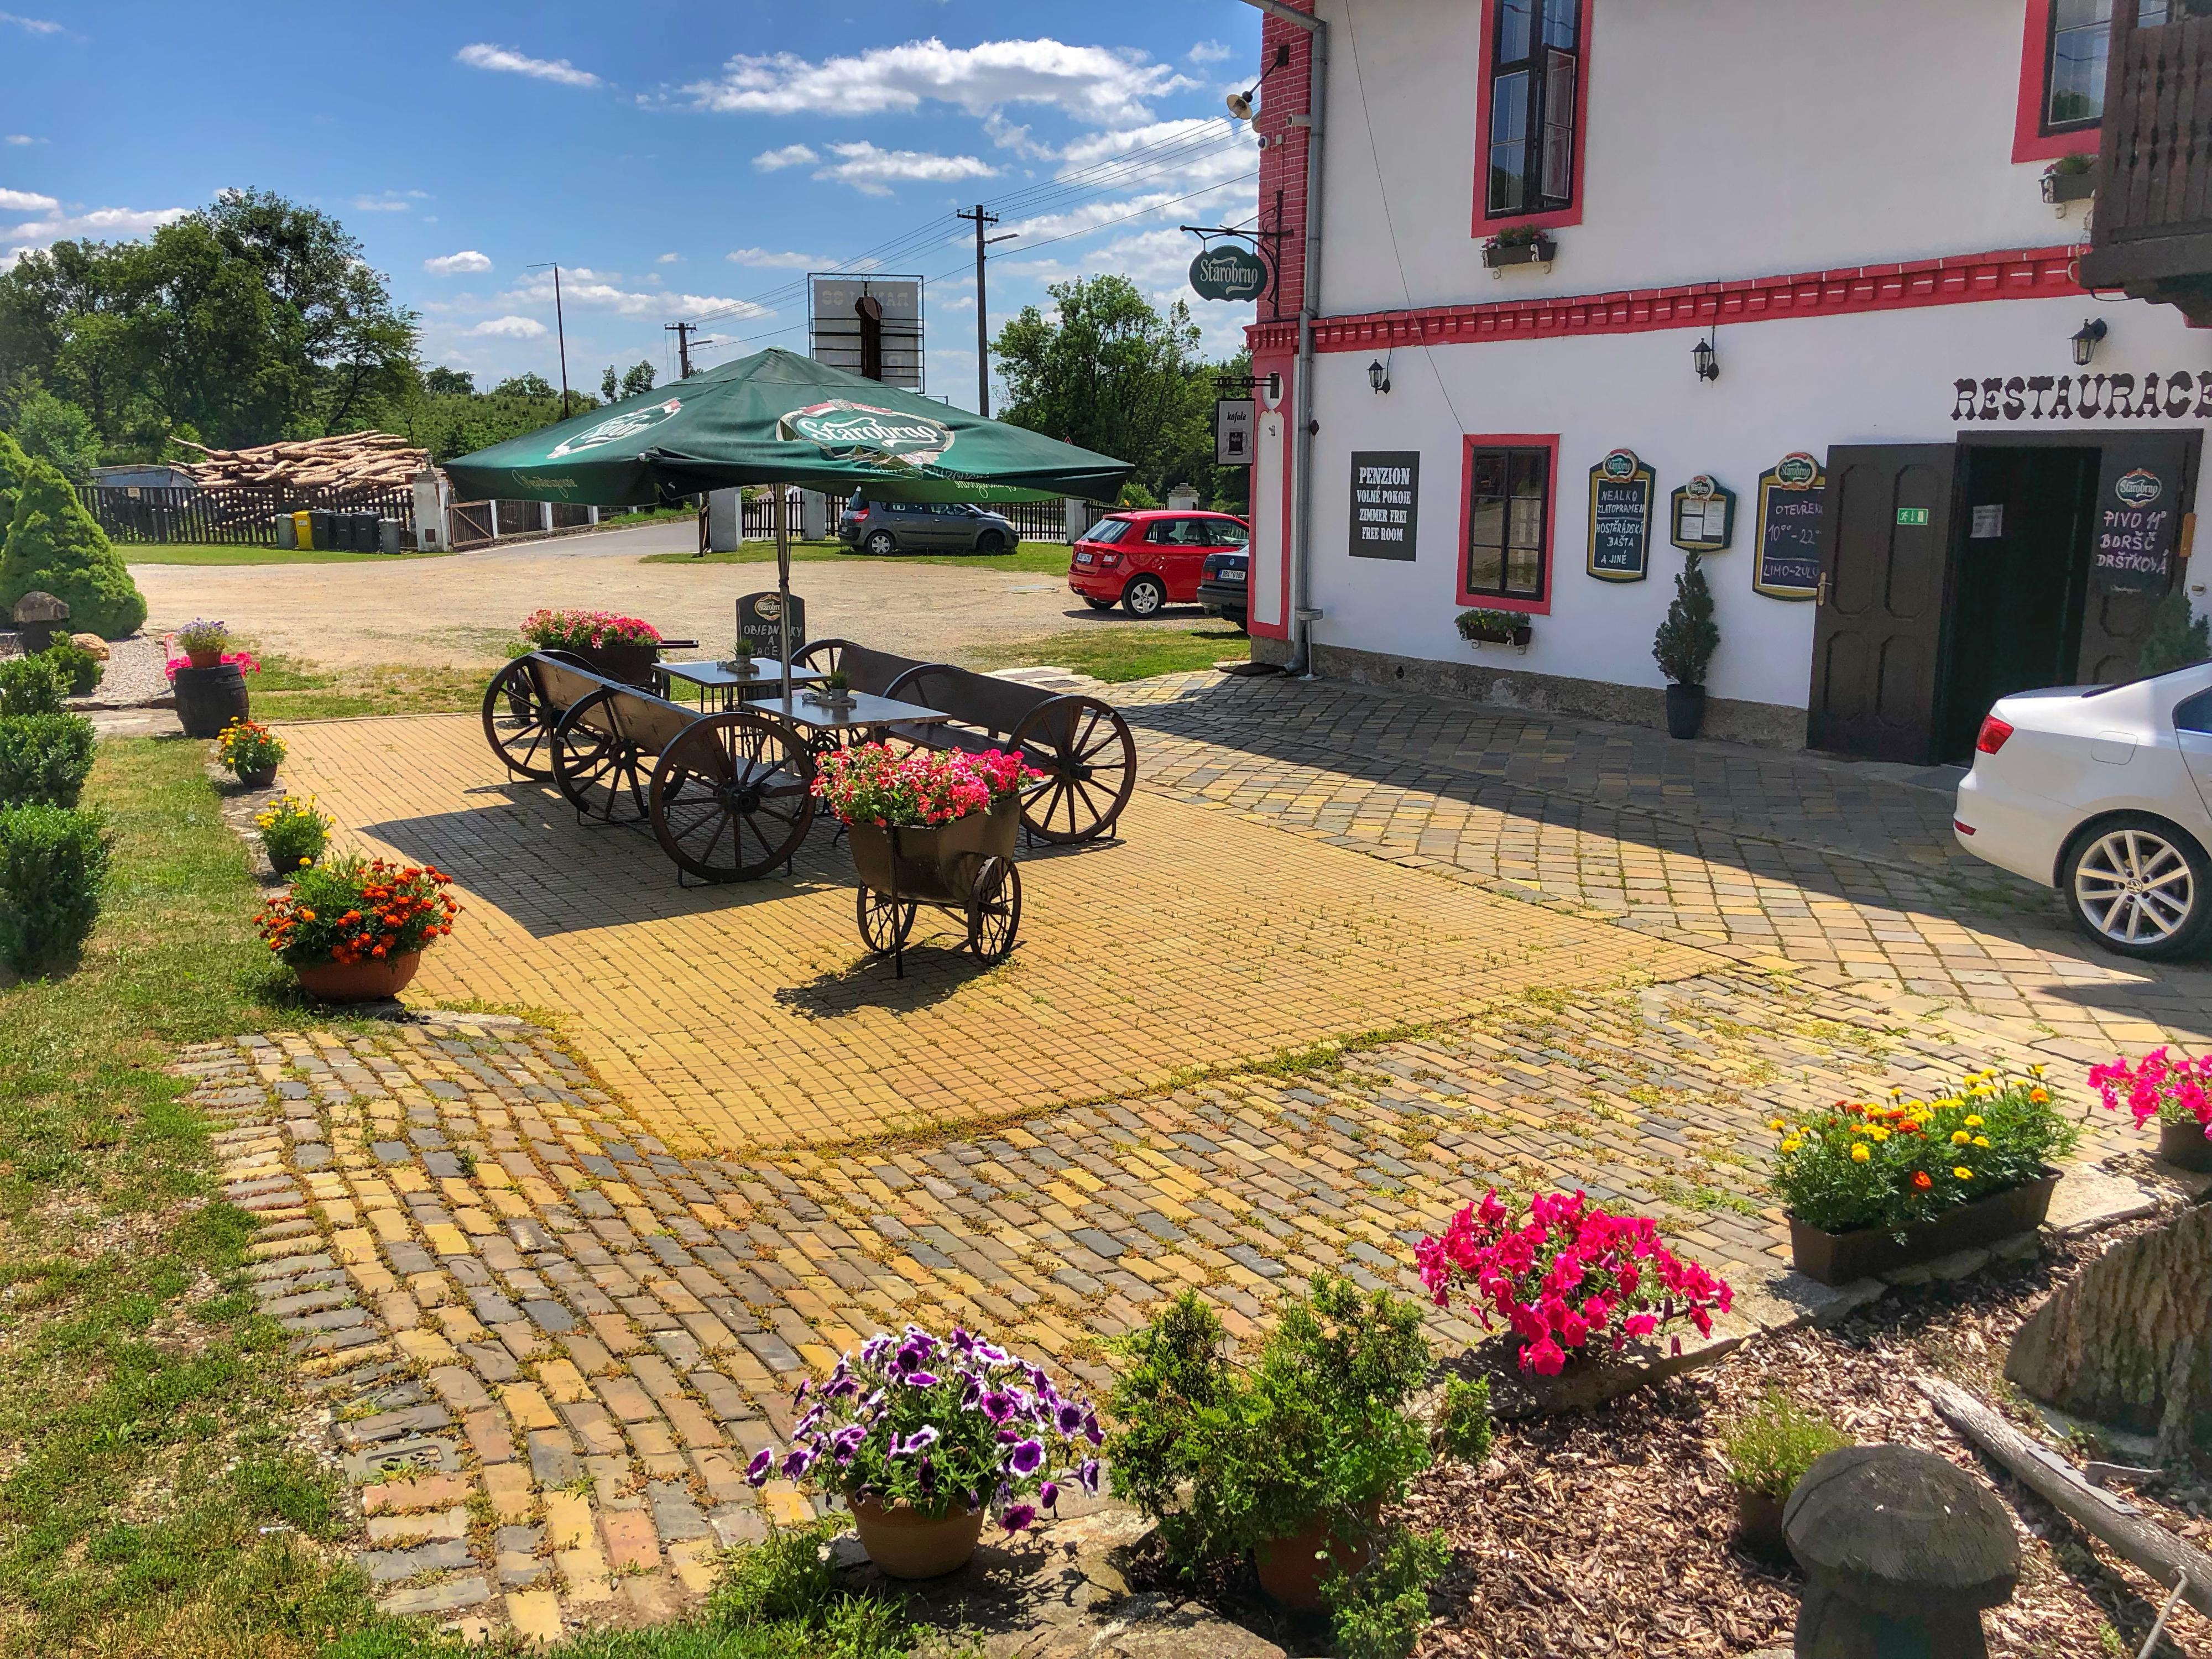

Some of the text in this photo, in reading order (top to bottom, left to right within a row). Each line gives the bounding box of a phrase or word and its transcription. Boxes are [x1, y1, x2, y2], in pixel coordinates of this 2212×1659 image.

[1200, 256, 1258, 295] Starobrno
[1950, 371, 2212, 421] RESTAURACE
[1227, 411, 1247, 424] kofola
[801, 417, 939, 447] Starobrno
[1606, 458, 1631, 474] Starobrno
[1780, 463, 1811, 481] Starobrno
[1359, 467, 1410, 485] PENZION
[1357, 485, 1411, 504] VOLNÉ POKOJE
[1601, 490, 1637, 501] NEALKO
[2120, 479, 2158, 498] Starobrno
[1597, 504, 1645, 514] ZLATOPRAMEN
[1775, 500, 1823, 515] OTEVŘEN
[1359, 508, 1407, 523] ZIMMER FREI
[2104, 510, 2142, 529] PIVO
[1361, 526, 1404, 541] FREE ROOM
[1606, 535, 1634, 547] BAŠTA
[2100, 530, 2157, 550] BORŠČ
[1601, 550, 1627, 565] A JINÉ
[2096, 549, 2169, 575] DRŠŤKOVÁ
[757, 601, 781, 614] Starobrn
[744, 624, 802, 638] OBJEDNKY
[768, 635, 774, 646] A
